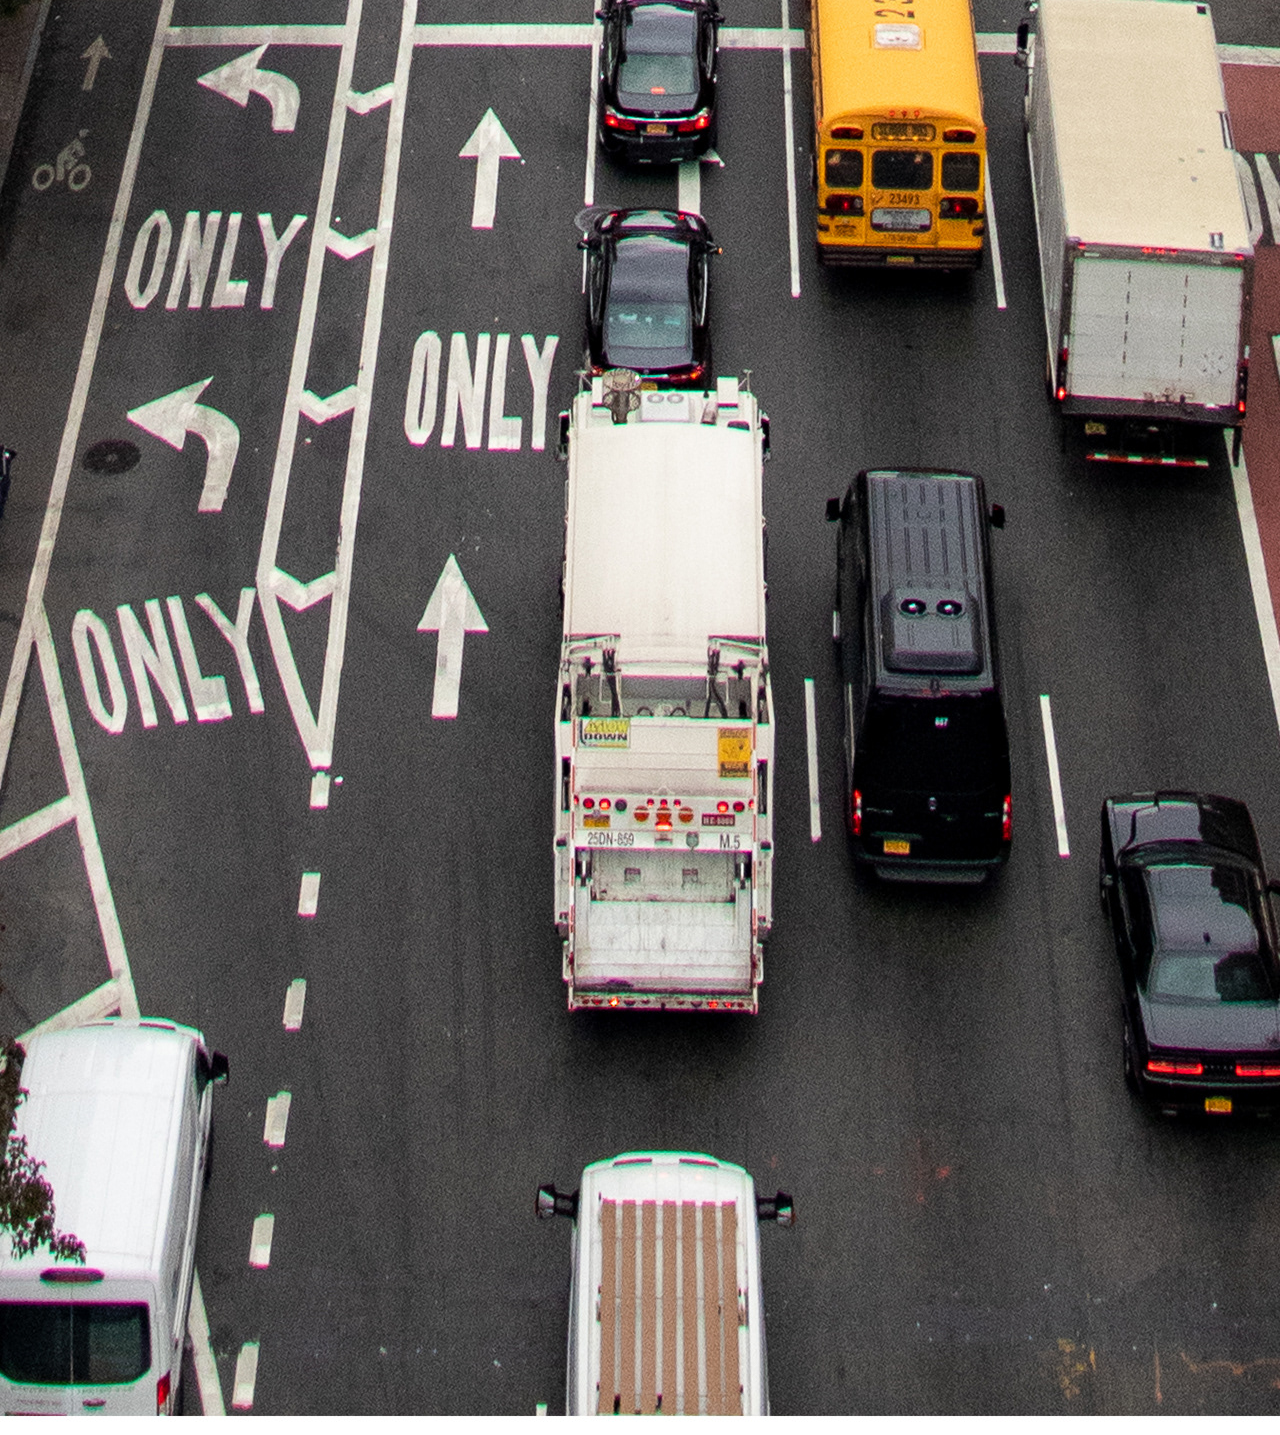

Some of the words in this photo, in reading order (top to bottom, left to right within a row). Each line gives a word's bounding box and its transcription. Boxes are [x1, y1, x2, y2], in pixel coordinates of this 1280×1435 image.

[889, 194, 920, 205] 23493
[123, 209, 308, 311] ONLY
[403, 329, 560, 451] ONLY
[72, 587, 265, 734] ONLY
[584, 733, 628, 741] DOWN
